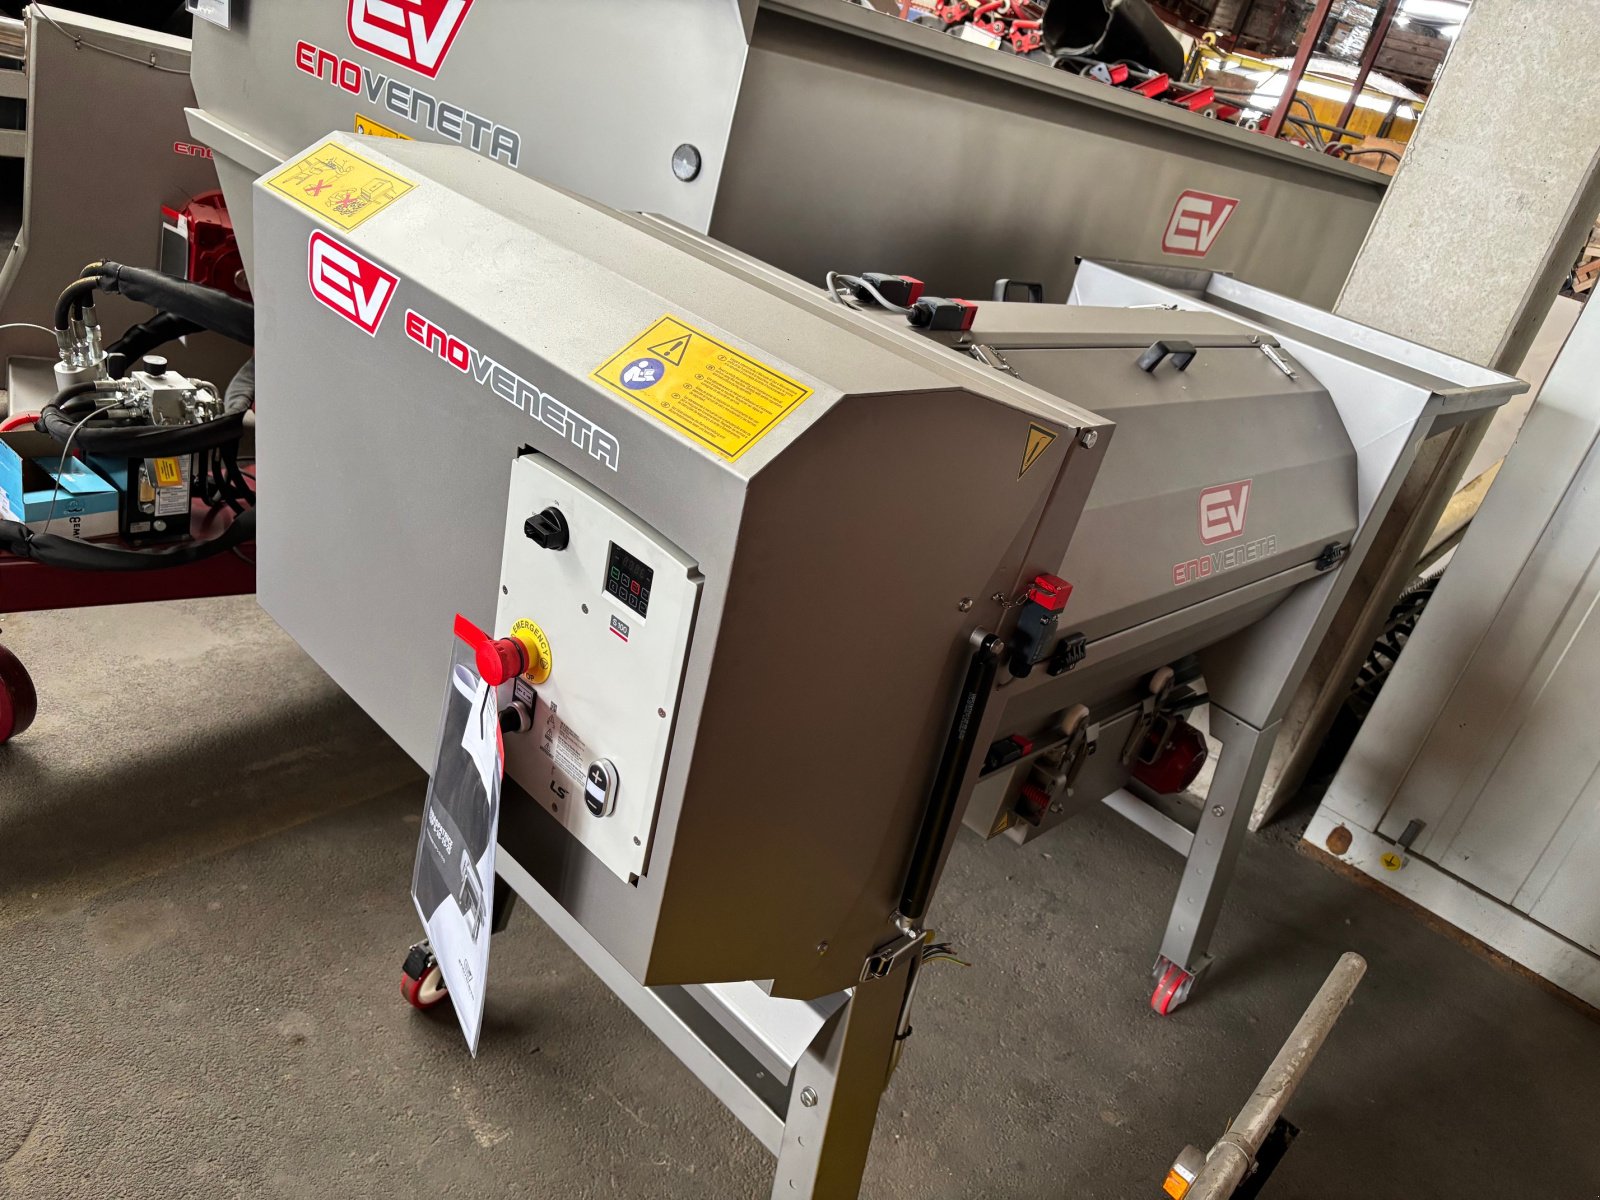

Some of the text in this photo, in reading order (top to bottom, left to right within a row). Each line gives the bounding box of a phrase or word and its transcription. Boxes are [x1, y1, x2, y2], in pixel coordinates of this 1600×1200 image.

[295, 40, 521, 167] ENOVENETA
[1165, 196, 1234, 252] EV
[311, 236, 392, 328] EV
[404, 308, 620, 472] ENOVENETA
[1200, 484, 1249, 540] EV
[1172, 534, 1279, 586] ENOVENETA
[512, 620, 549, 657] EMERGENCY
